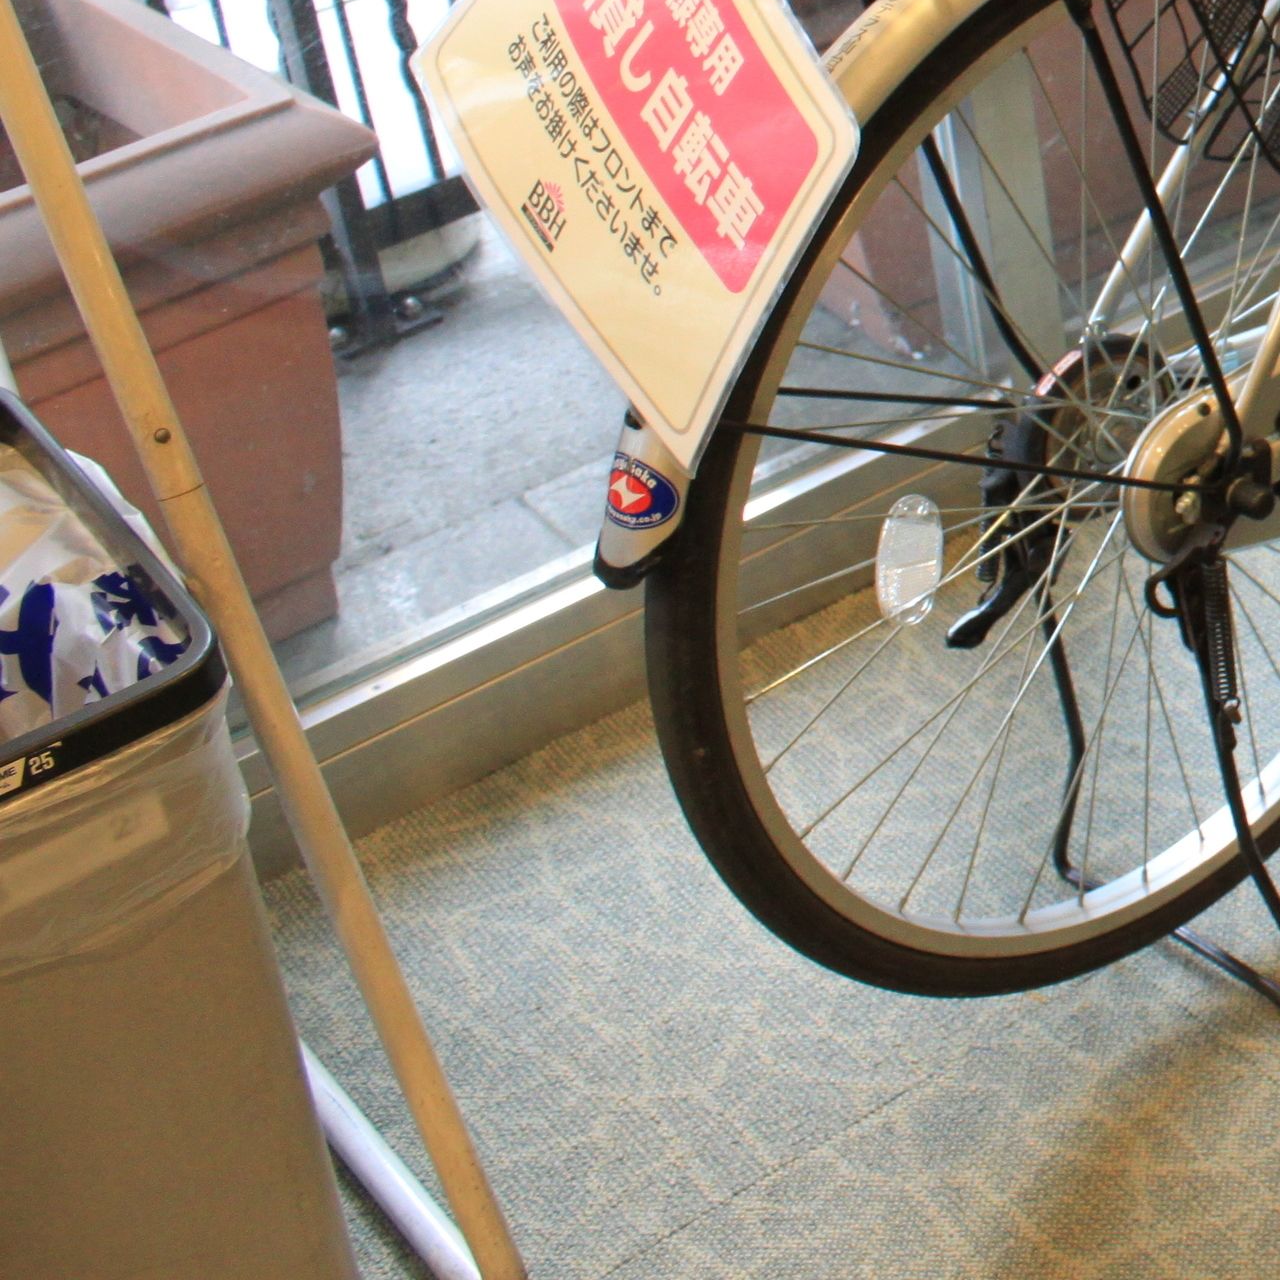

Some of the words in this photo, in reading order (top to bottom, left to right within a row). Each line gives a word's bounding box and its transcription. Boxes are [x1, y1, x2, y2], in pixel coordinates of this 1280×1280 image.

[506, 40, 661, 298] お声をお掛けくださいませ。
[528, 178, 567, 240] BBH
[531, 12, 678, 258] ご利用の際はフロントまで
[28, 751, 55, 776] 25
